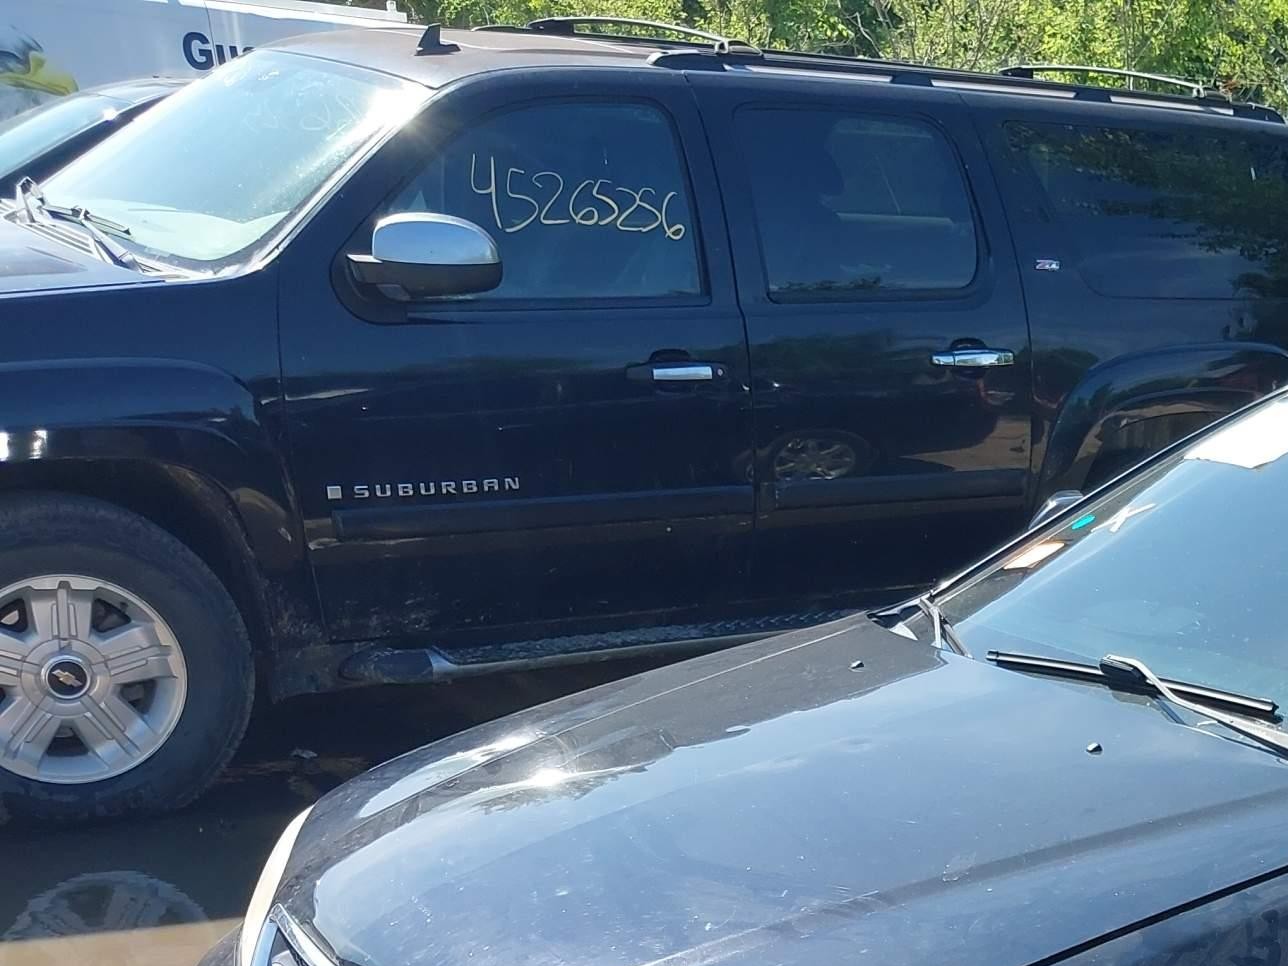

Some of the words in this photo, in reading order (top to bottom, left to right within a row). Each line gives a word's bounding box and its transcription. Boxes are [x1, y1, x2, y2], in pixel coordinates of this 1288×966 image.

[182, 31, 256, 71] Gu
[470, 153, 686, 240] 45265256
[353, 477, 520, 498] SUBURBAN
